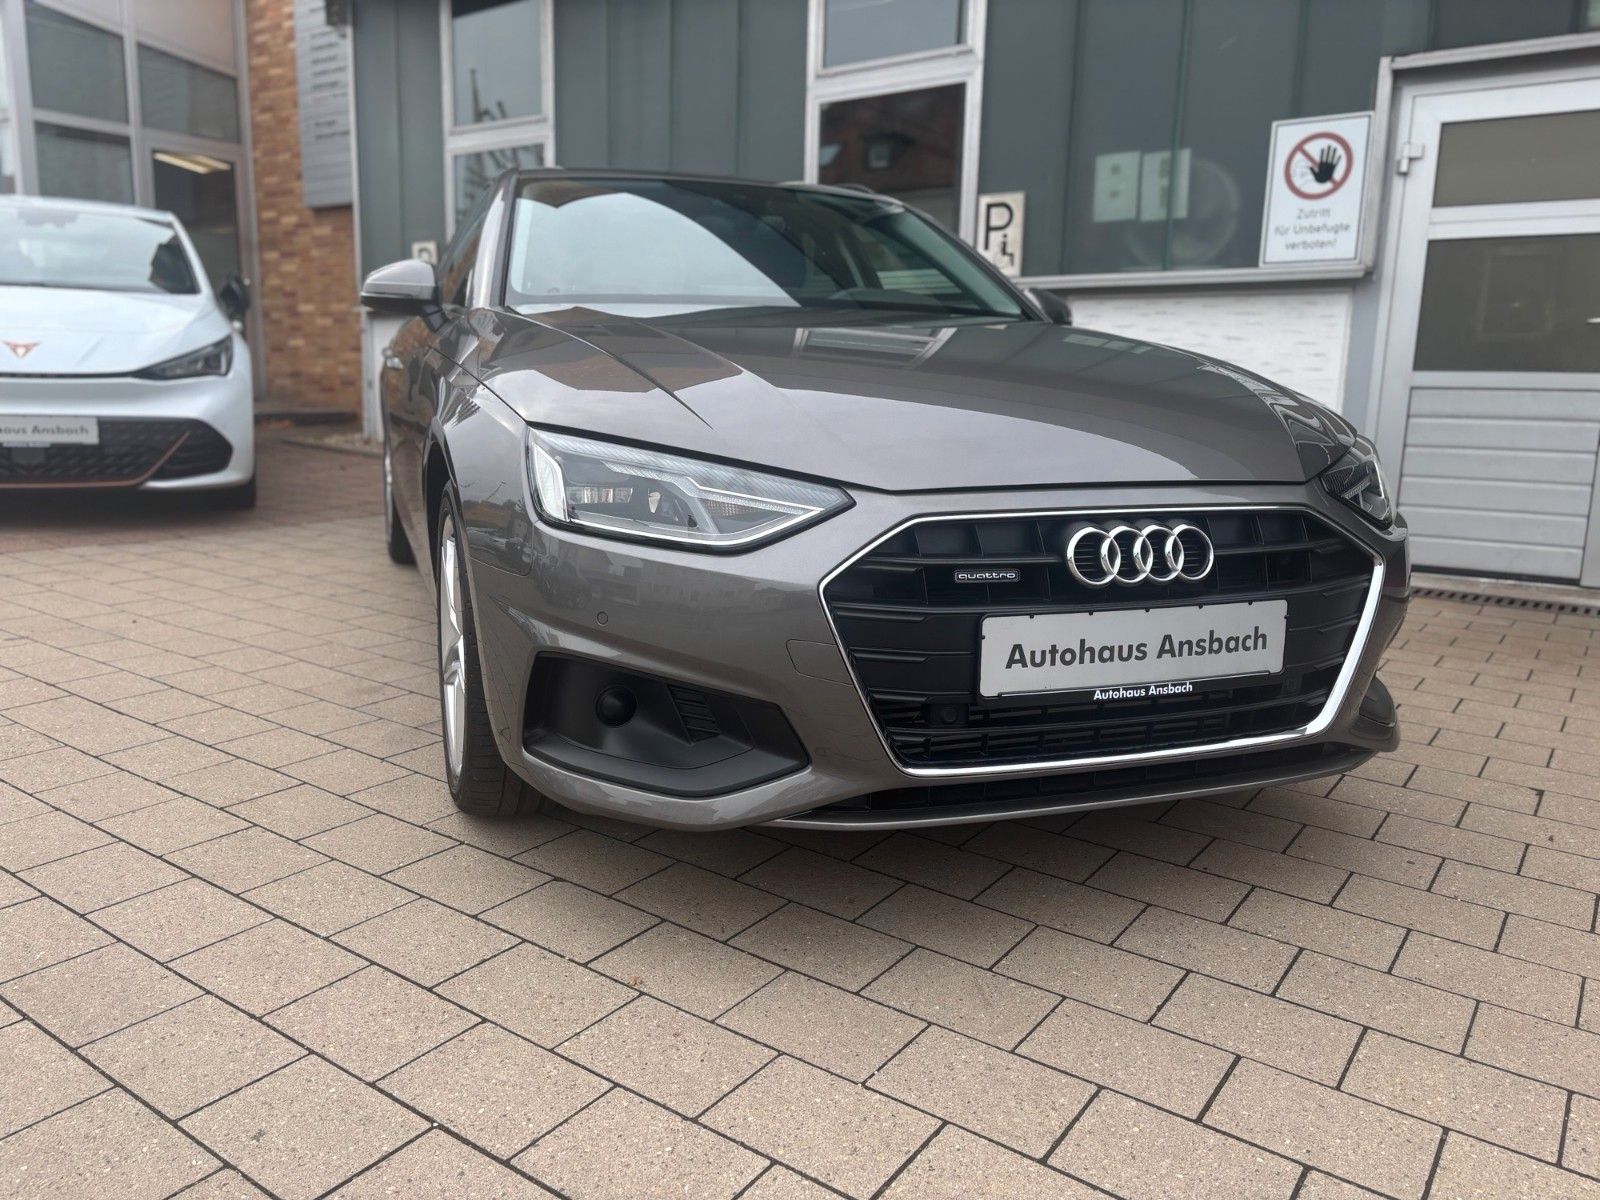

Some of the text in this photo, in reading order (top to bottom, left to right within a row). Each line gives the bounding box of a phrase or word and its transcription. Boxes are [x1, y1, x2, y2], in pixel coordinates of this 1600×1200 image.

[1296, 207, 1331, 220] Zutritt
[984, 202, 1014, 251] P
[1274, 222, 1351, 236] für Unbefugte
[1284, 239, 1337, 251] verboten!
[31, 424, 89, 435] Ansbach
[958, 572, 1016, 581] quattro
[1005, 625, 1268, 669] Autohaus Ansbach
[1093, 681, 1193, 700] Autohaus Ansbach
